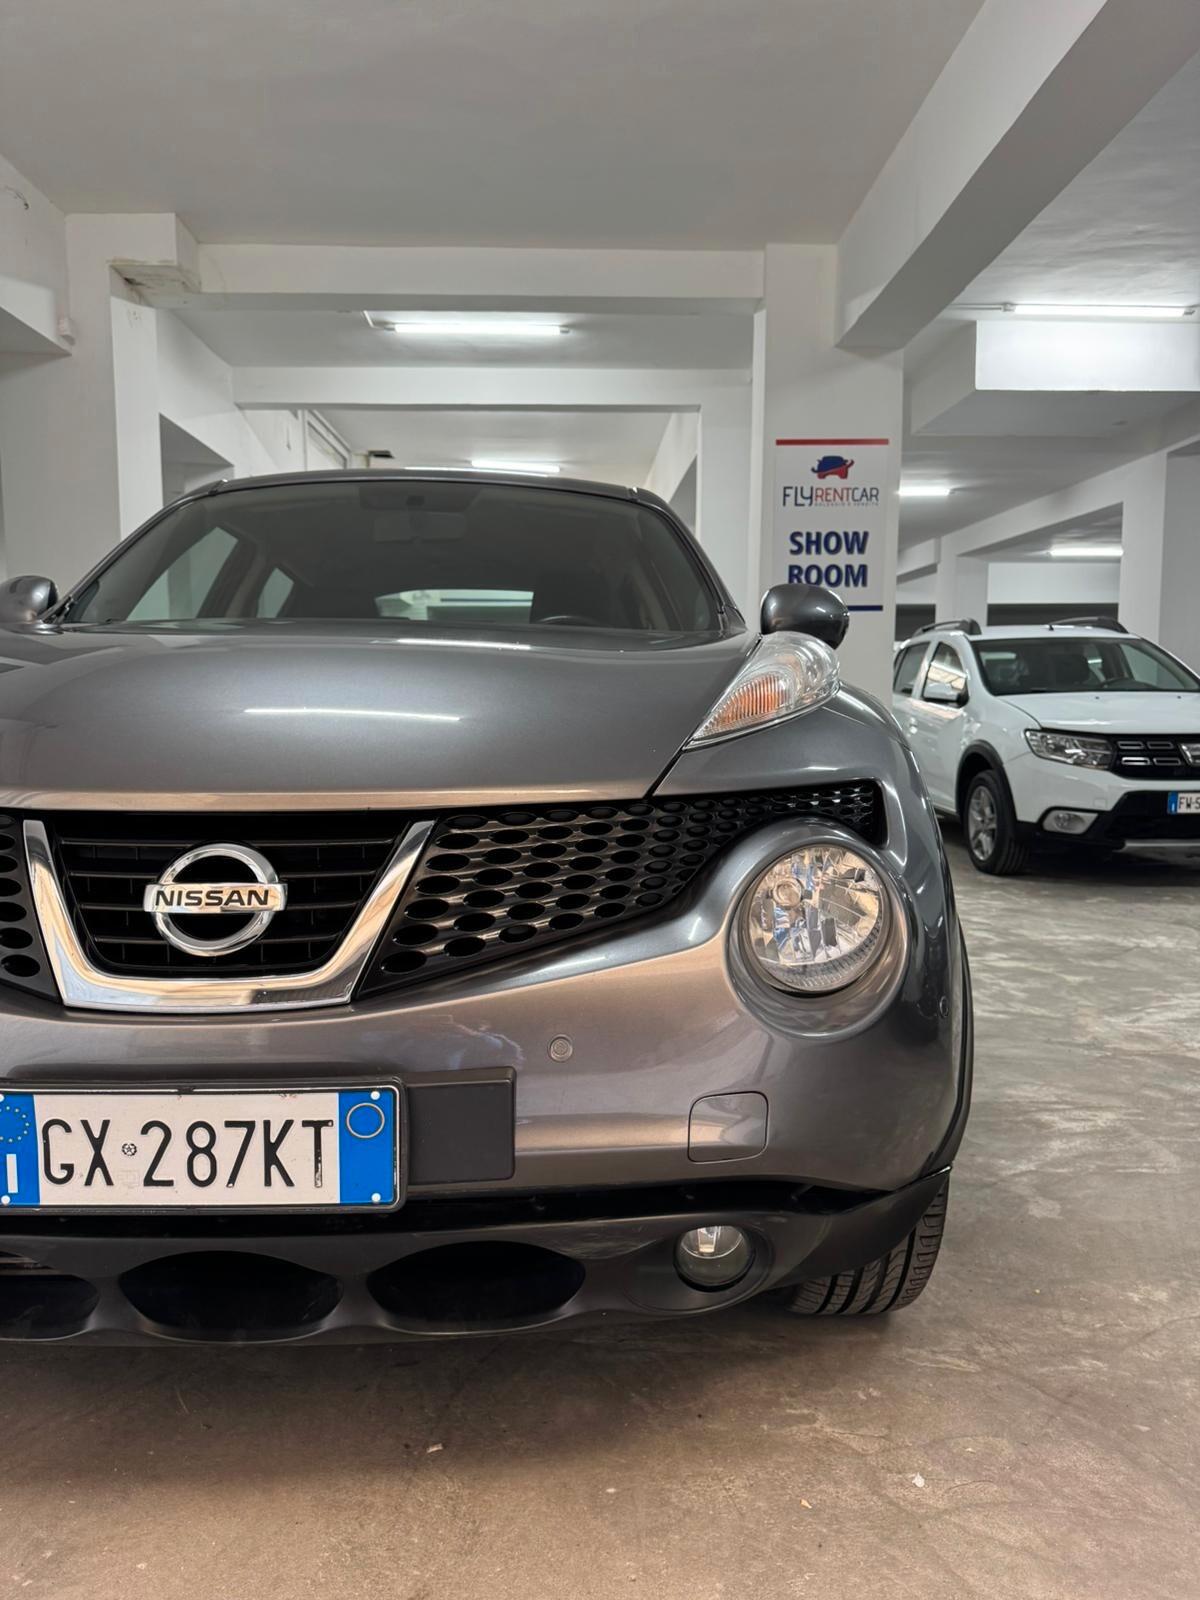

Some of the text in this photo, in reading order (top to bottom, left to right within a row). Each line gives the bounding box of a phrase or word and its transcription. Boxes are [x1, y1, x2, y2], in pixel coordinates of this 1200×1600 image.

[783, 486, 880, 506] FLYRENTCAR
[789, 531, 869, 555] SHOW
[788, 563, 868, 588] ROOM
[155, 889, 269, 906] NISSAN
[41, 1119, 334, 1187] GX 287KT
